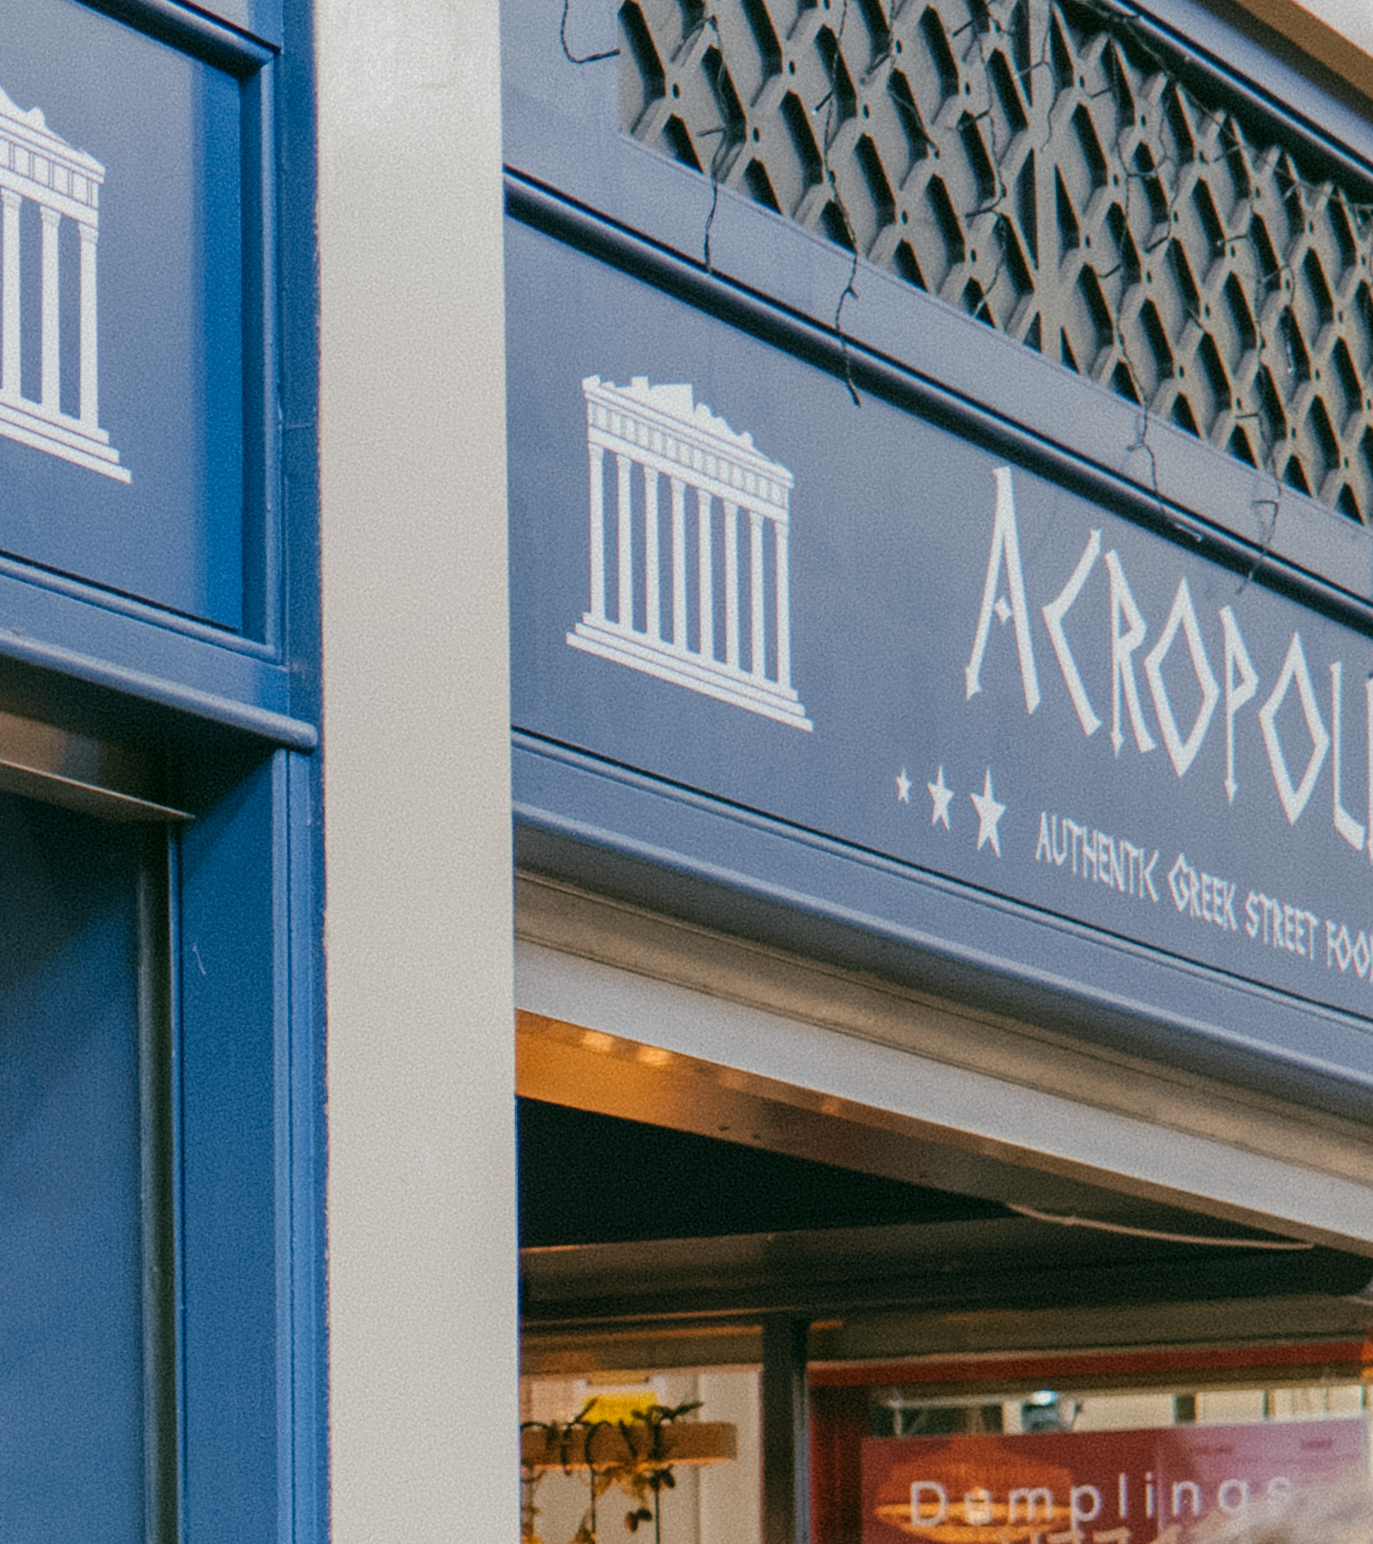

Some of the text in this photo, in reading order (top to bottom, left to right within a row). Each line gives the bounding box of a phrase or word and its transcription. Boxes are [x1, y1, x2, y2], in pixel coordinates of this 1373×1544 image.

[963, 465, 1373, 864] ACROPOLI
[1035, 811, 1373, 983] AUTHENTIC GREEK STREET FOO
